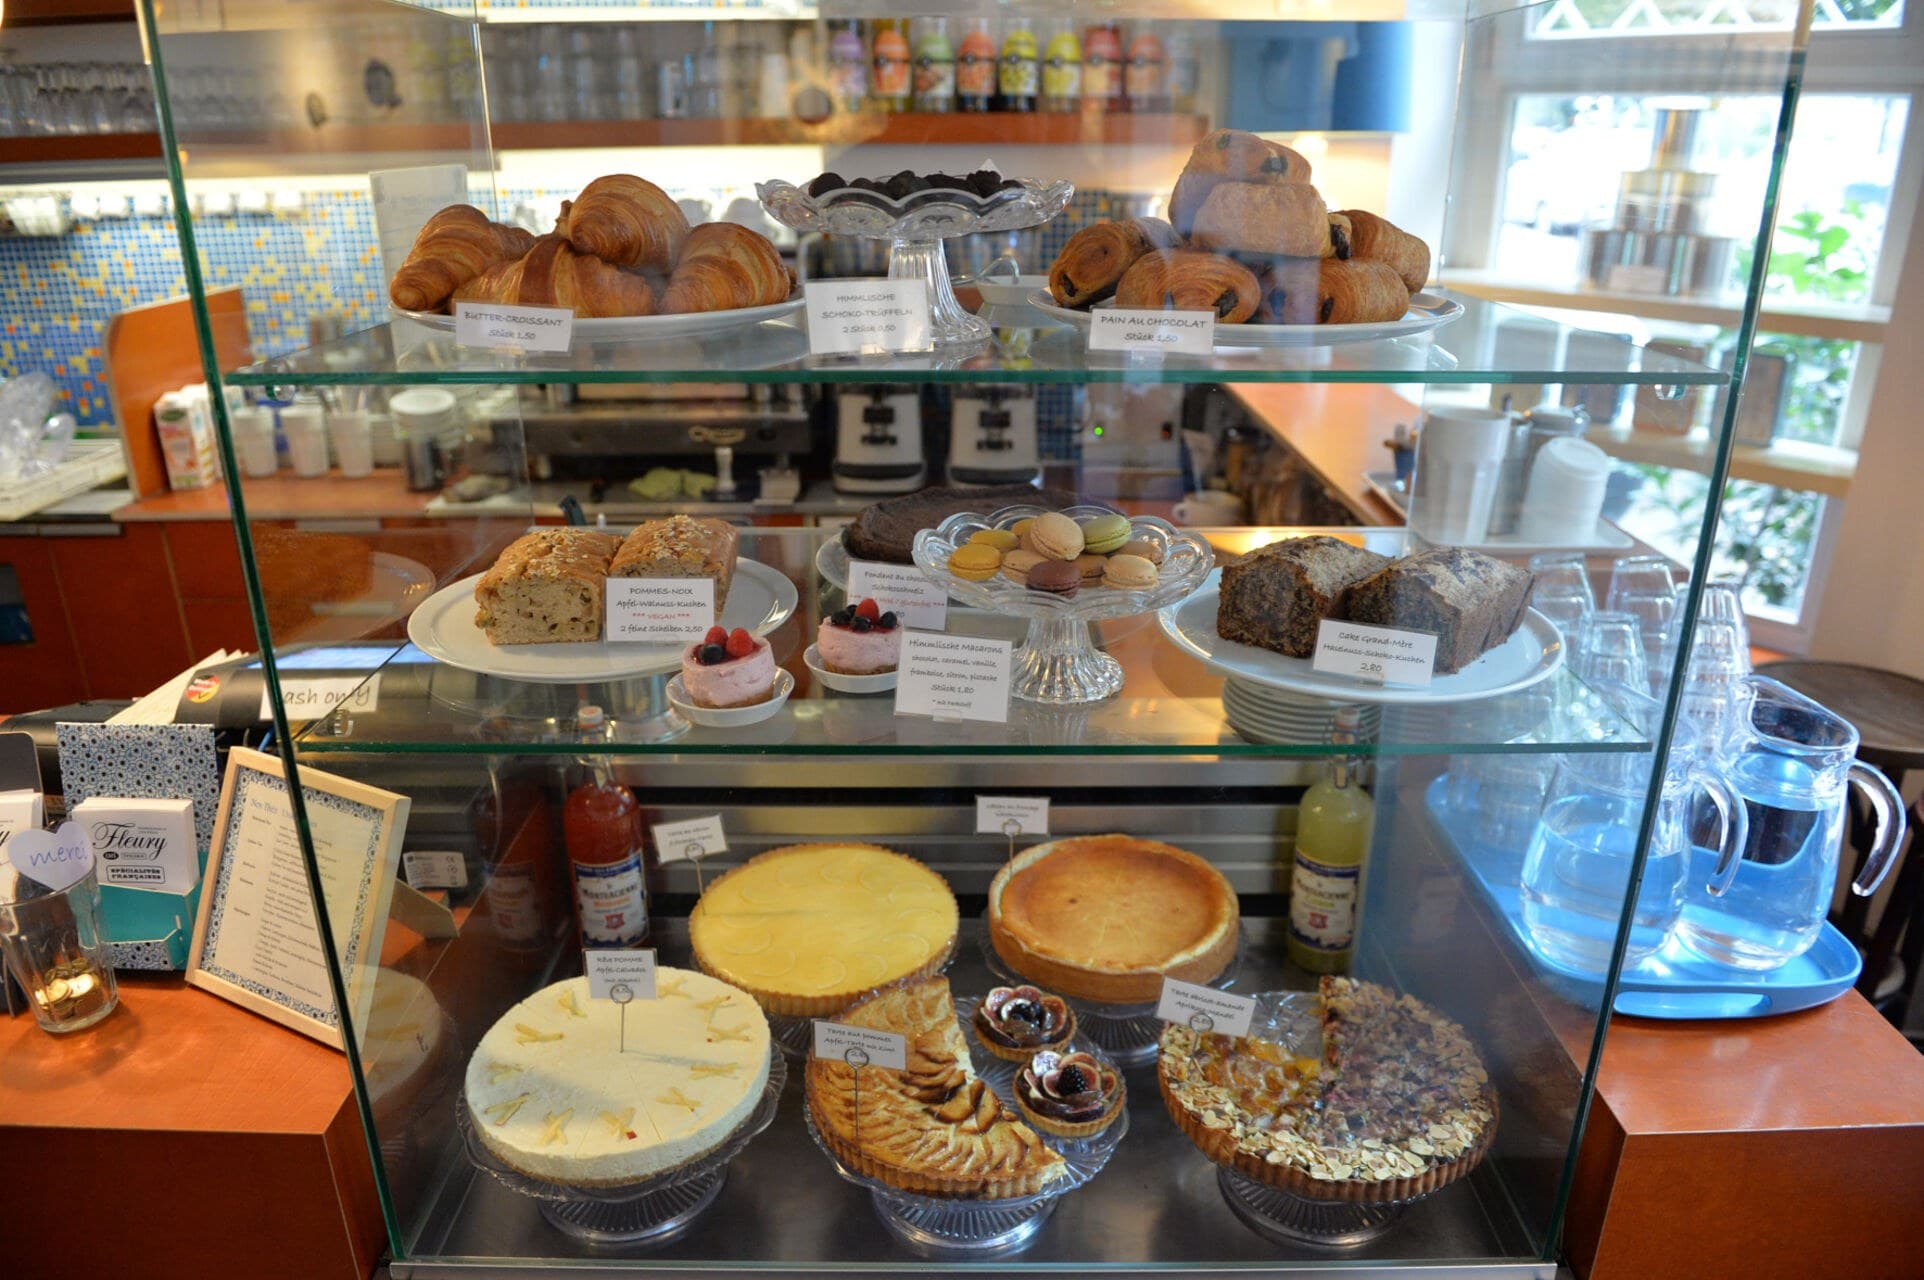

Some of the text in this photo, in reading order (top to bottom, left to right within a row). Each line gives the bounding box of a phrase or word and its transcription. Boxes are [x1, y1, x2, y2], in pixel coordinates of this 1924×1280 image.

[464, 311, 564, 326] BUTTER-CROISSANT
[1101, 316, 1126, 324] PAIN
[1146, 318, 1208, 328] CHOCOLAT
[1124, 332, 1154, 341] Stück
[628, 624, 648, 634] feine
[1338, 632, 1360, 641] Cake
[909, 639, 1003, 654] Himmlische Macarons
[930, 684, 956, 693] Stück
[281, 687, 318, 705] ash
[92, 821, 168, 861] Fleury
